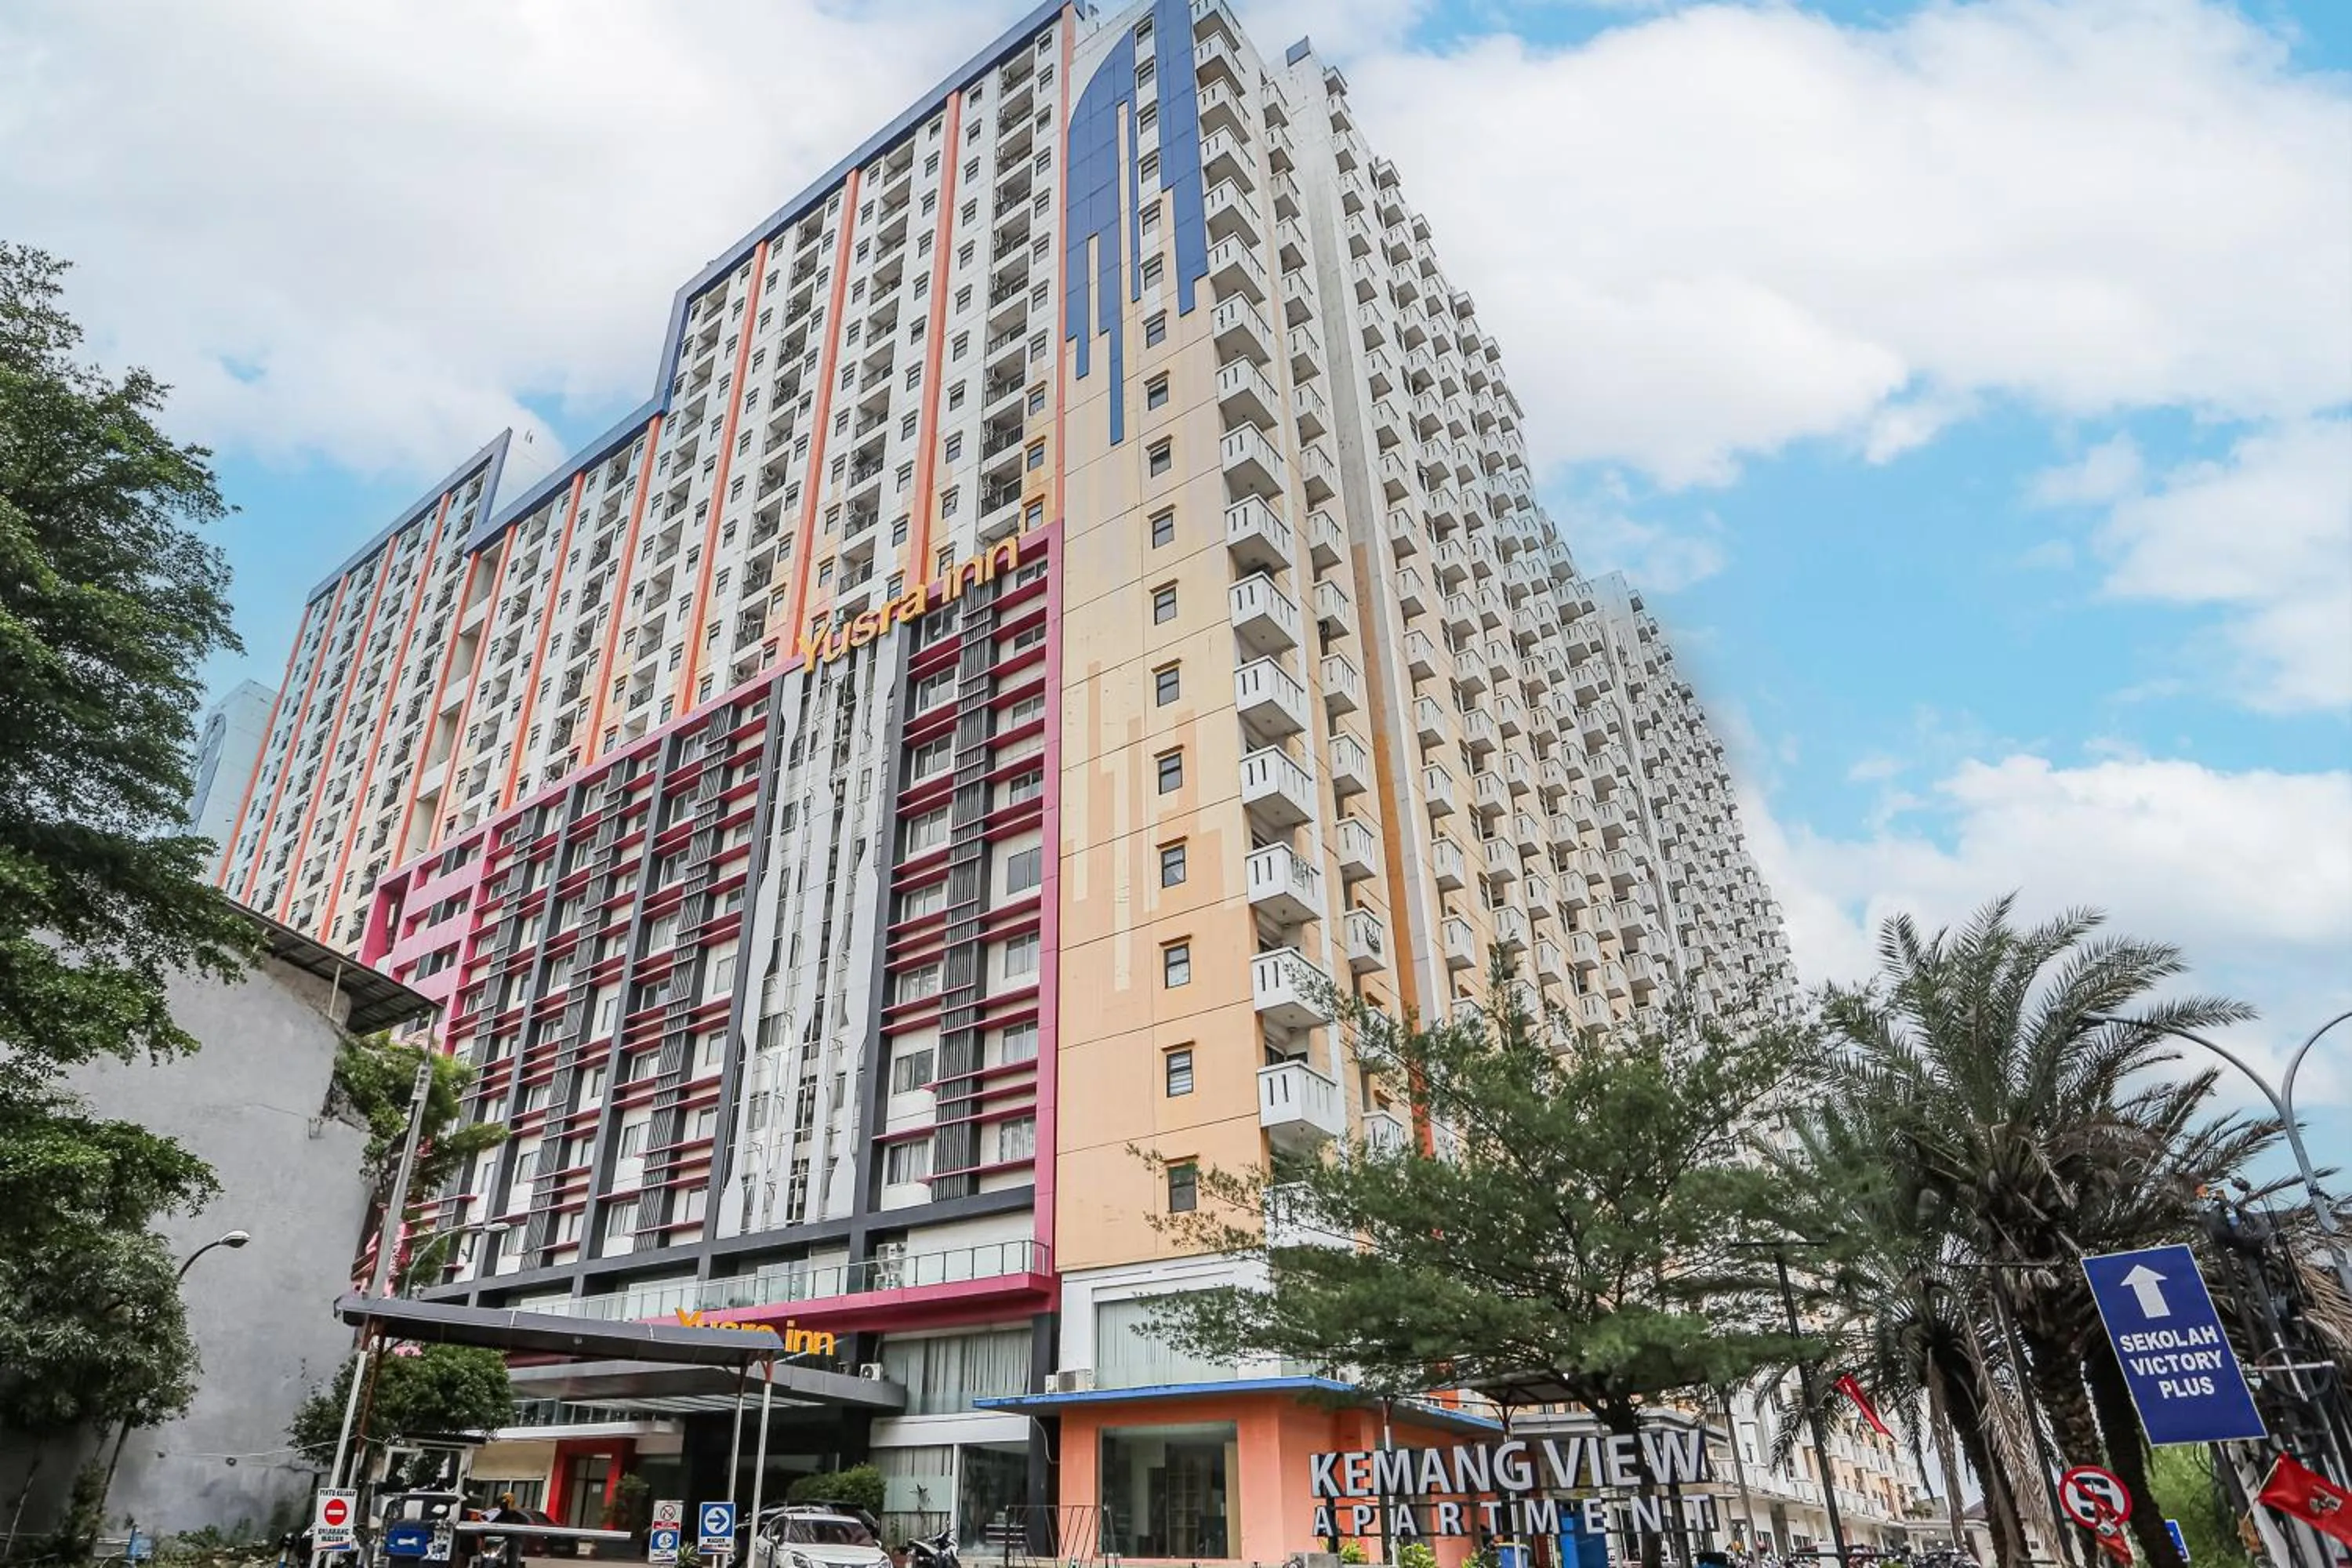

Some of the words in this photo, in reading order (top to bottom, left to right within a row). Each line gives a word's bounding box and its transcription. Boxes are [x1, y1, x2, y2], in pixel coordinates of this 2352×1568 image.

[797, 583, 928, 674] Yusra
[942, 536, 1019, 603] inn
[785, 1319, 833, 1356] inn
[2119, 1324, 2220, 1352] SEKOLAH
[2129, 1349, 2222, 1376] VICTORY
[2158, 1376, 2215, 1399] PLUS
[1310, 1442, 1532, 1497] KEMANG
[1542, 1428, 1704, 1489] VIEW
[1312, 1494, 1719, 1537] APARTMENT
